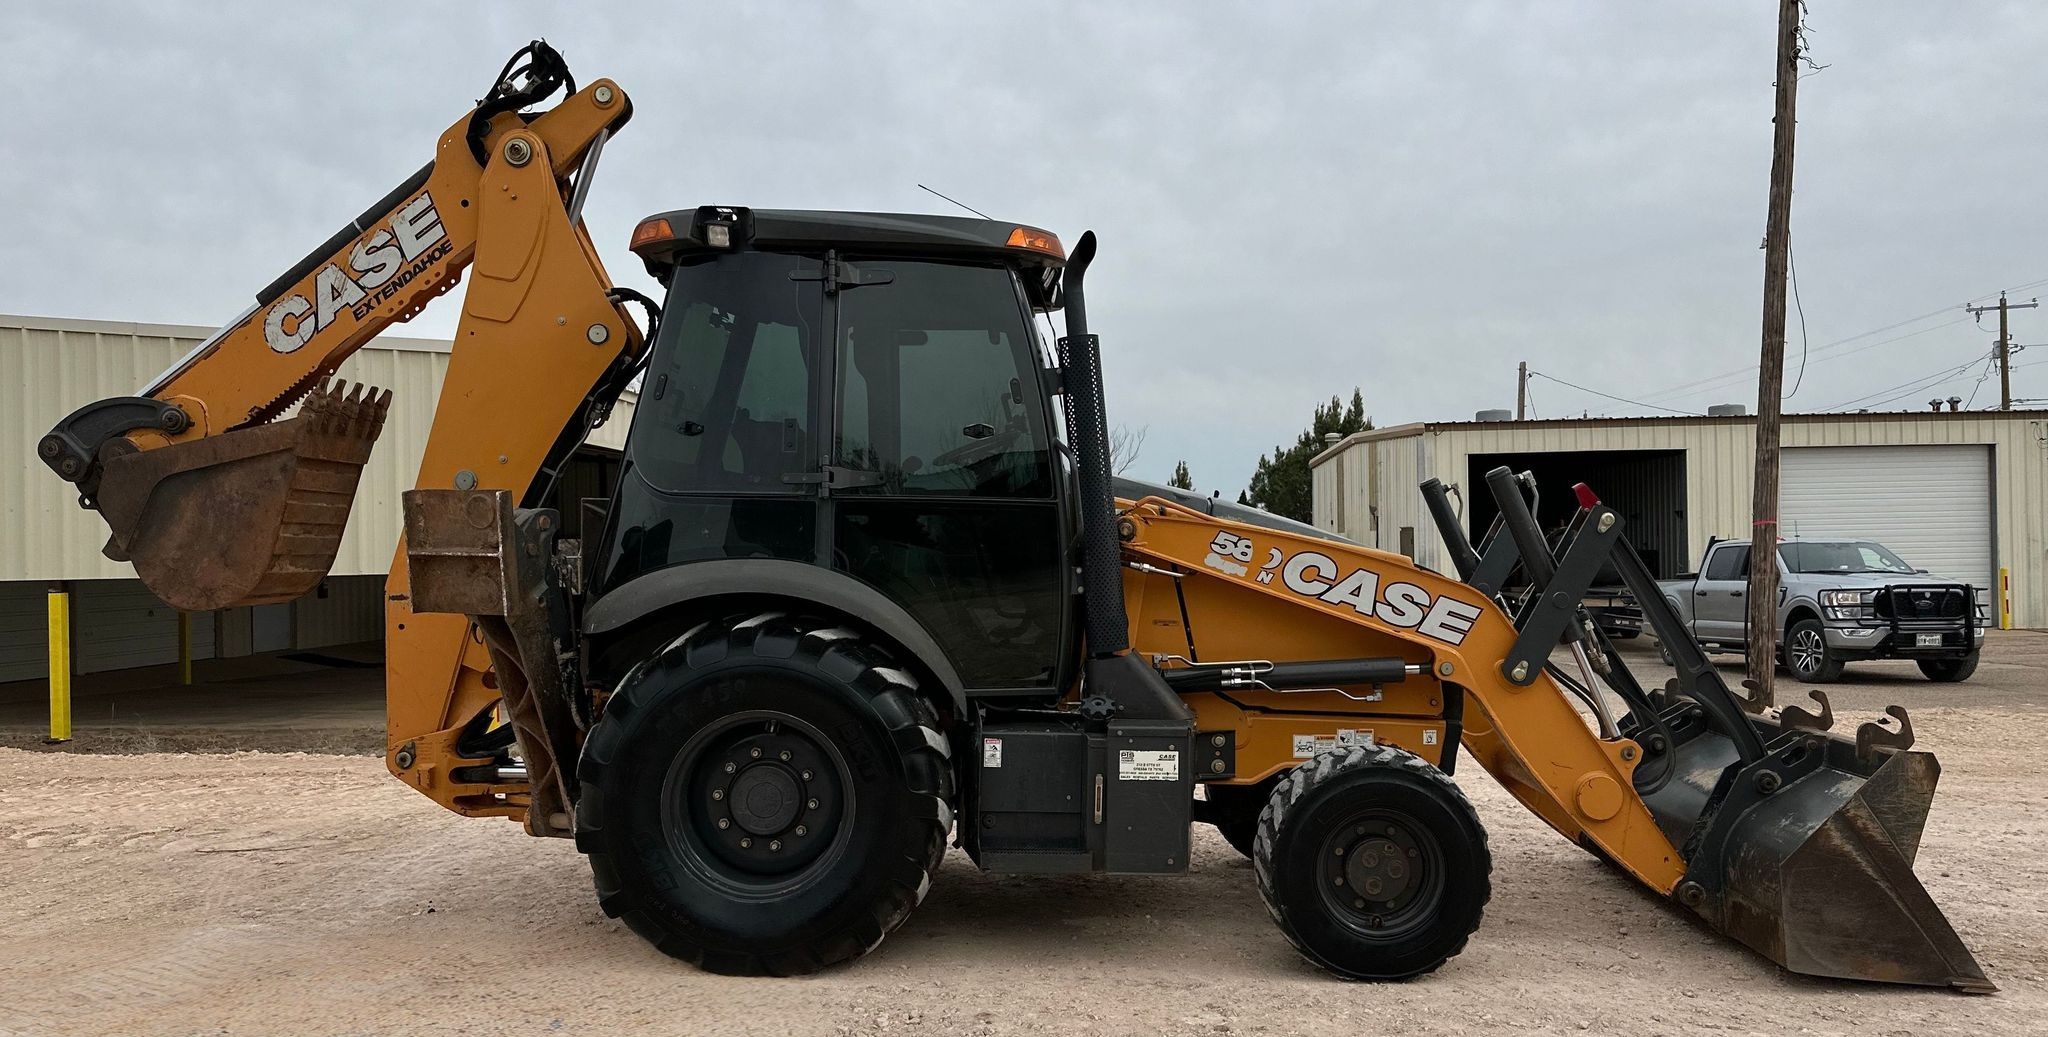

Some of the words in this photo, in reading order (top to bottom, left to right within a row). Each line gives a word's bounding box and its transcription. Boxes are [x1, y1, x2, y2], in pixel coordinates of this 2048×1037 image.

[263, 189, 448, 354] CASE
[352, 239, 454, 322] EXTENDAHOE
[1281, 550, 1484, 647] CASE
